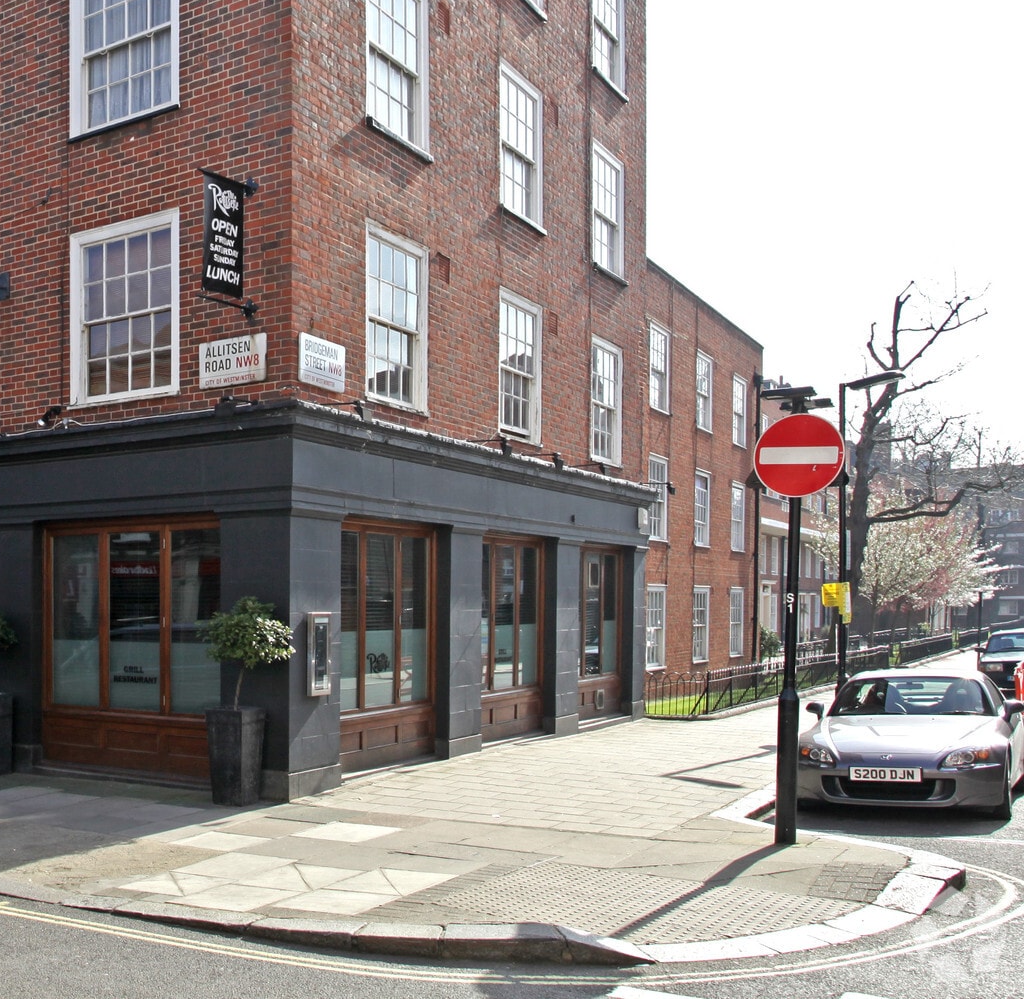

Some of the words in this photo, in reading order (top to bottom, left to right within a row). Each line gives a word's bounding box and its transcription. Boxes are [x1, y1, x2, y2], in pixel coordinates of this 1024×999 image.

[211, 218, 238, 237] OPEN
[214, 235, 235, 247] FRIDAY
[209, 243, 238, 258] SATURDAY
[213, 254, 236, 266] SUNDAY
[206, 265, 240, 285] LUNCH
[205, 340, 251, 358] ALLITSEN
[304, 339, 339, 360] BRIDGEMAN
[205, 359, 231, 373] ROAD
[236, 354, 260, 368] NW8
[305, 354, 327, 372] STREET
[328, 362, 342, 376] NW8
[223, 374, 255, 383] WESTMINSTER
[786, 593, 794, 603] S
[787, 604, 793, 613] 1
[124, 666, 144, 674] GRILL
[113, 675, 157, 684] RESTAURANT
[854, 769, 886, 779] S200
[890, 769, 914, 779] DJN
